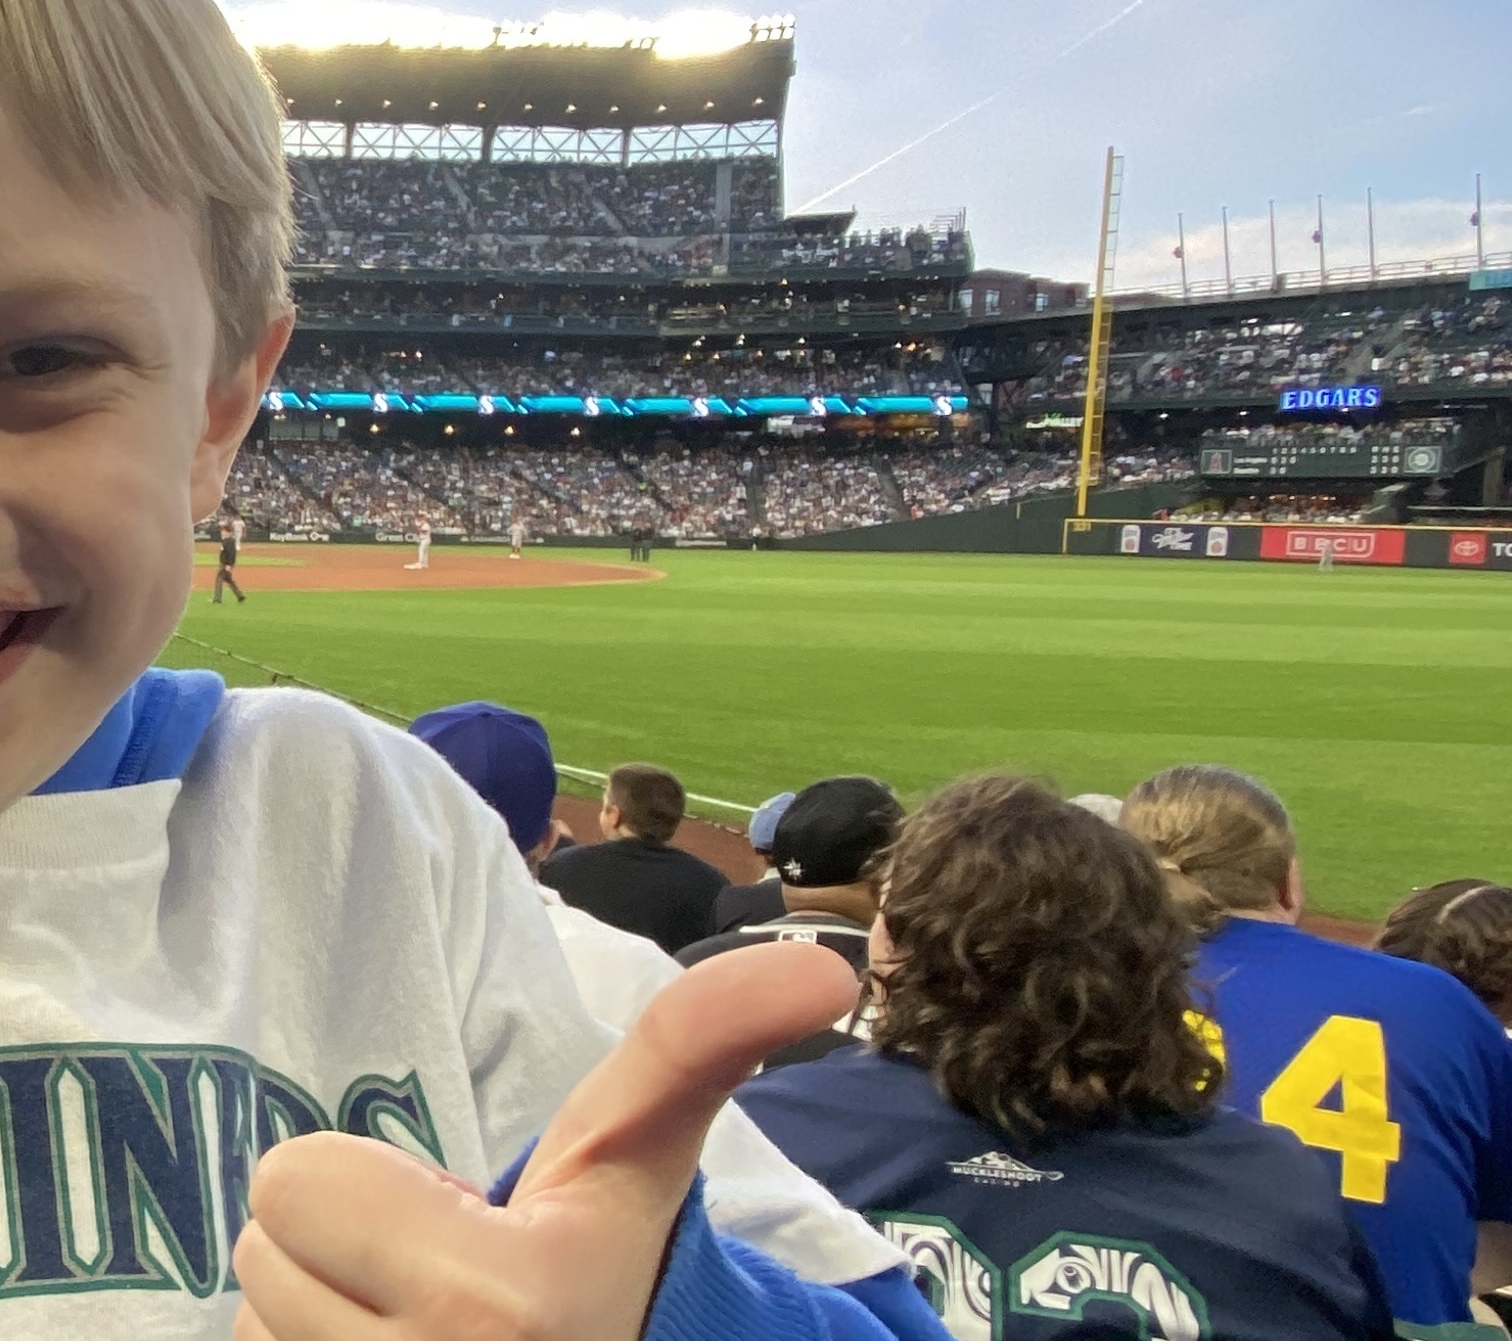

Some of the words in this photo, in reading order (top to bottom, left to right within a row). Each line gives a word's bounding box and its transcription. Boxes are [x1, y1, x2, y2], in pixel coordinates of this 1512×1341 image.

[1281, 388, 1378, 410] EDGARS
[1294, 536, 1368, 553] BECU
[952, 1166, 1042, 1183] MUCKLESHOOT
